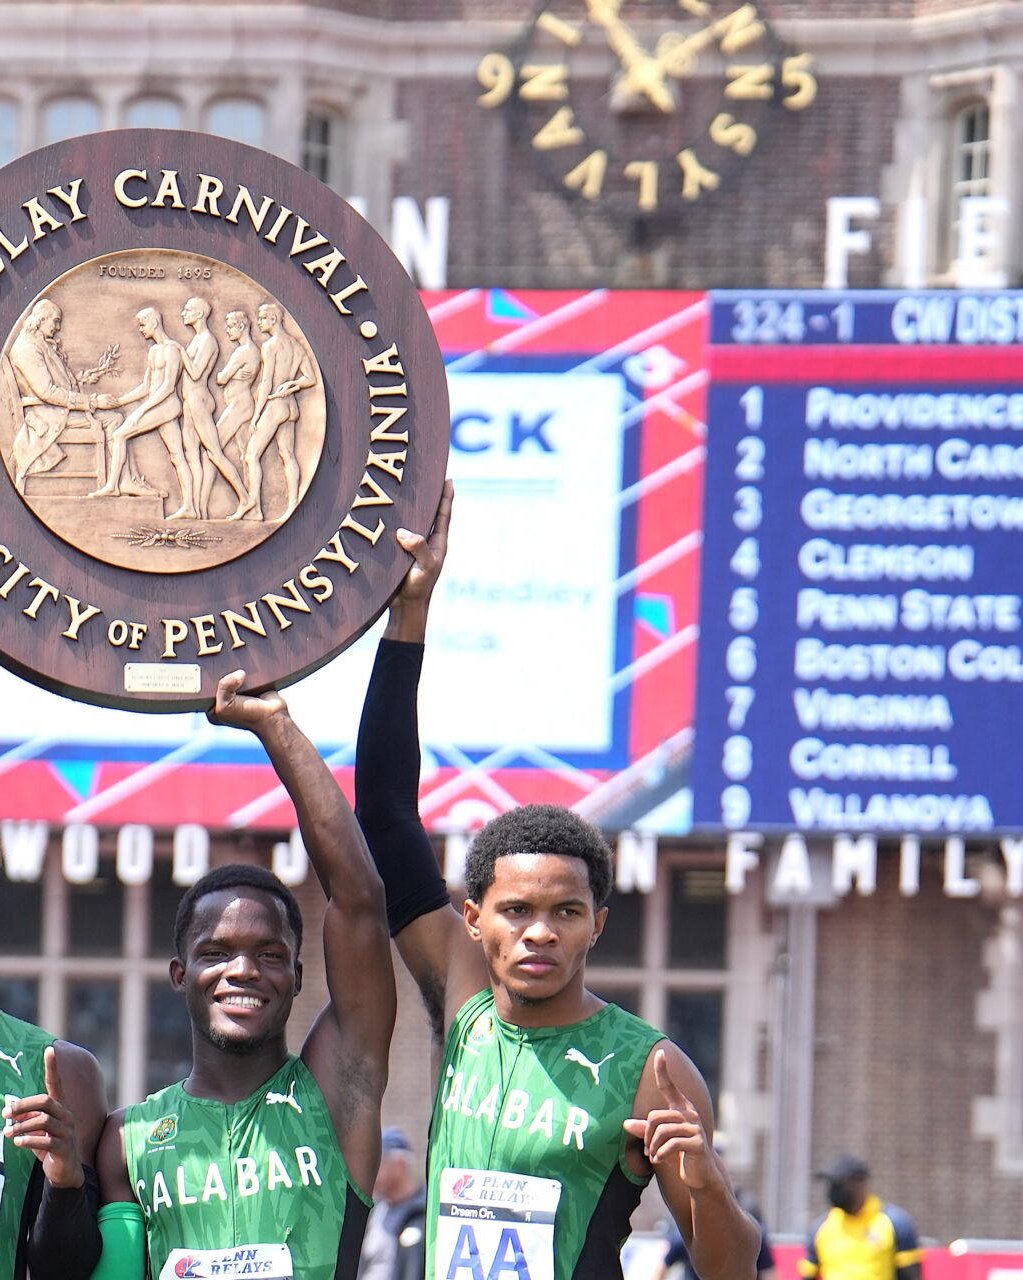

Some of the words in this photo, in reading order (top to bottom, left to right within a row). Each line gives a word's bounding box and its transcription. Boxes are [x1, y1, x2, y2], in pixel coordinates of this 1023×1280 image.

[113, 168, 369, 317] CARNIVAL
[98, 264, 167, 280] FOUNDED
[177, 267, 213, 280] 1895
[738, 385, 765, 431] 1
[805, 386, 1023, 431] PROVIDENCE
[735, 435, 766, 482] 2
[804, 437, 934, 481] NORTH
[107, 618, 149, 651] OF
[160, 341, 410, 660] PENNSYLVANIA
[732, 485, 763, 532] 3
[729, 536, 761, 582] 4
[798, 538, 975, 582] CLEMSON
[728, 586, 759, 633] 5
[796, 588, 899, 632] PENN
[899, 588, 1022, 632] STATE
[726, 635, 757, 682] 6
[794, 637, 947, 681] BOSTON
[725, 685, 756, 731] 7
[792, 687, 955, 732] VIRGINIA
[722, 734, 753, 782] 8
[788, 737, 958, 781] CORNELL
[720, 784, 752, 830] 9
[788, 787, 995, 831] VILLANOVA
[136, 1145, 322, 1218] CALABAR
[482, 1176, 528, 1192] PENN
[450, 1205, 478, 1218] Dream
[478, 1207, 496, 1220] On.
[210, 1260, 273, 1276] RELAYS
